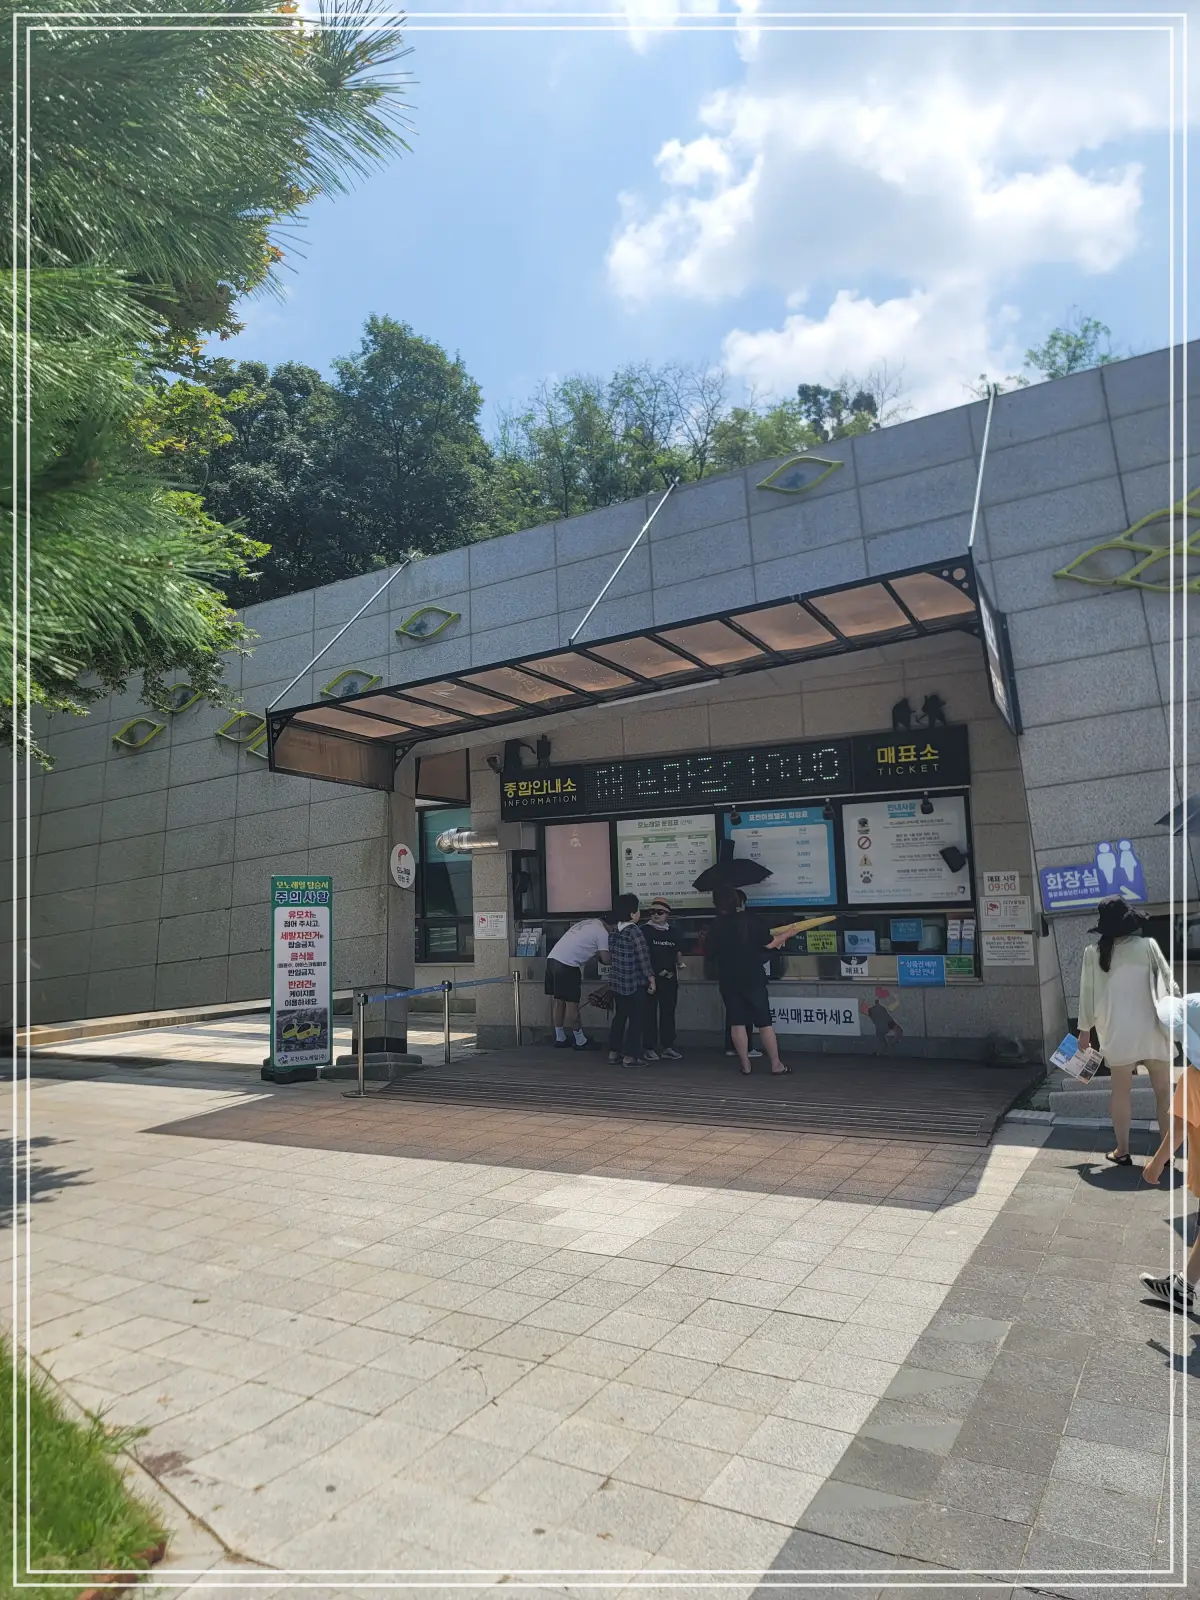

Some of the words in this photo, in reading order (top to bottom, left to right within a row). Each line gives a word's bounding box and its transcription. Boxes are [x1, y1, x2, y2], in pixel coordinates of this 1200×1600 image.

[877, 744, 940, 764] 매표소
[877, 764, 940, 777] TICKET
[503, 778, 577, 799] 종합안내소
[504, 795, 577, 808] INFORMATION
[1045, 868, 1100, 890] 화장실
[275, 881, 306, 890] 모노레일
[306, 881, 329, 890] 탑승시
[988, 882, 1017, 892] 09:00
[275, 890, 330, 904] 주의사항
[288, 910, 317, 920] 유모차는
[283, 920, 297, 928] 접어
[290, 951, 315, 961] 음식물
[289, 990, 315, 998] 케이지를
